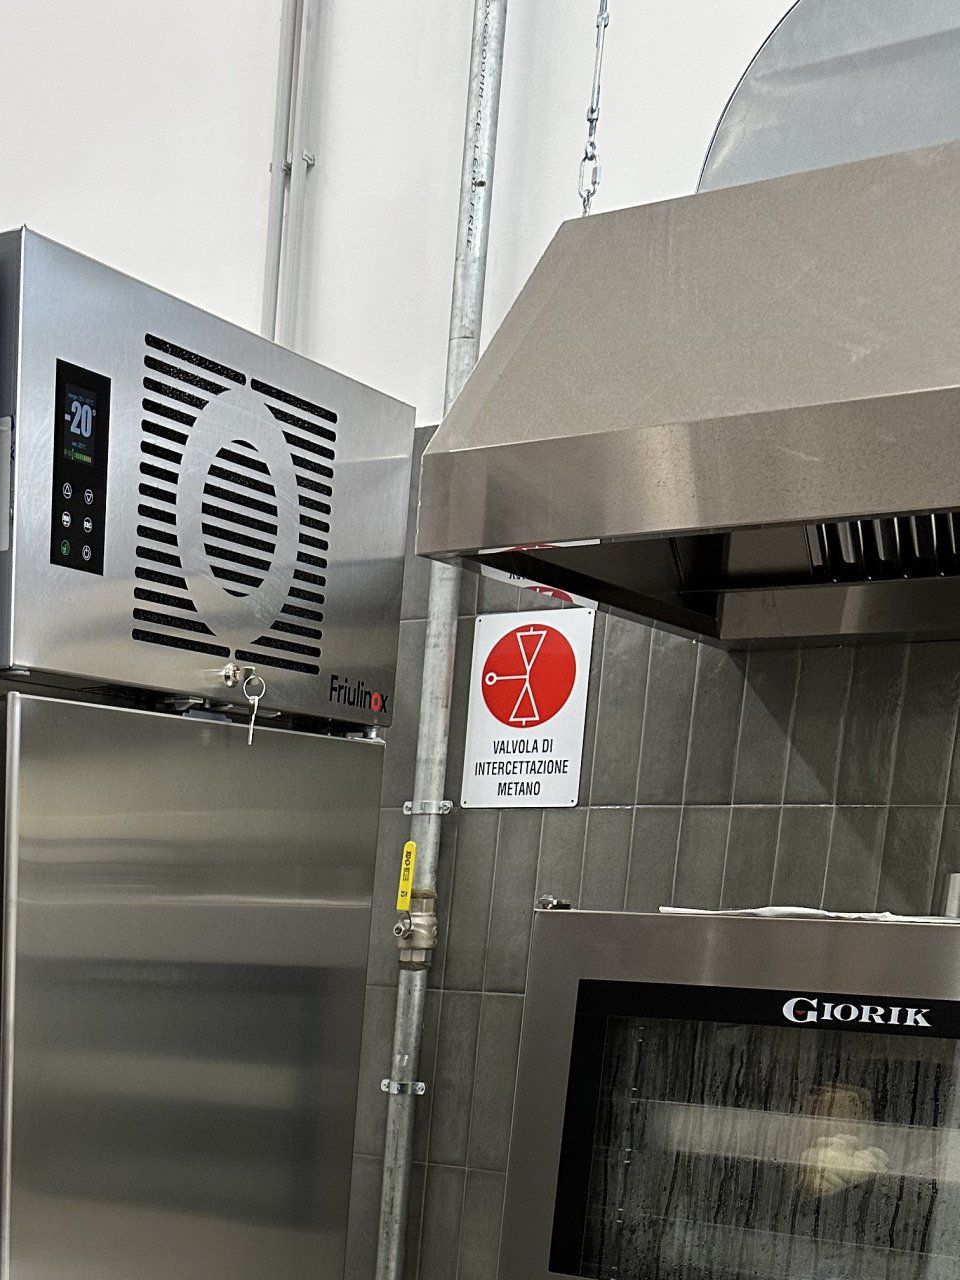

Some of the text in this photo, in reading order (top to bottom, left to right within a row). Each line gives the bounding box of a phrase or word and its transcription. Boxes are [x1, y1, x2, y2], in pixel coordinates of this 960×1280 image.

[329, 674, 388, 714] Friulinox
[493, 738, 554, 754] VALVOLA DI
[474, 759, 569, 776] INTERCETTAZIONE
[497, 781, 541, 796] METANO
[782, 997, 932, 1028] GIORIK
